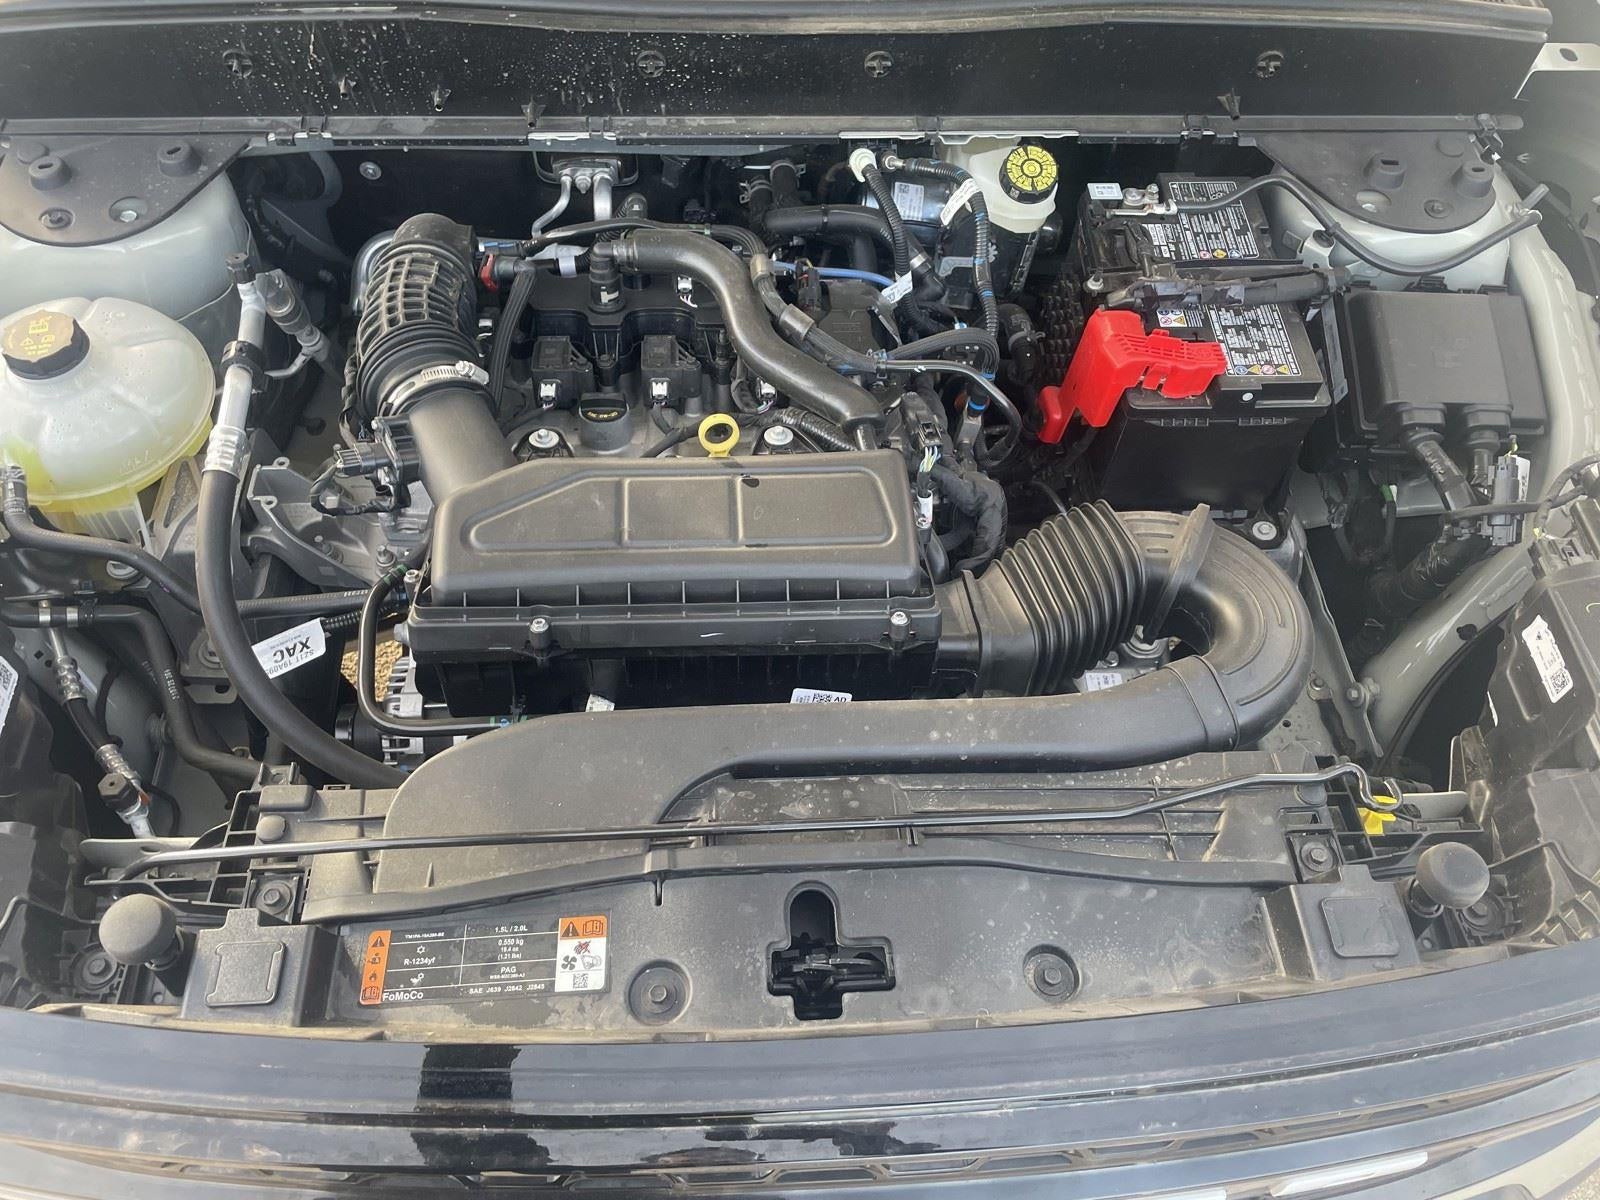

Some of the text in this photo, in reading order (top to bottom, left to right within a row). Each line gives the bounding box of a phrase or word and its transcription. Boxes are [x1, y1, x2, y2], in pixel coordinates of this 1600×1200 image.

[273, 636, 310, 664] XAC
[404, 956, 436, 966] R-1234yf
[382, 990, 424, 1002] FoMoCo
